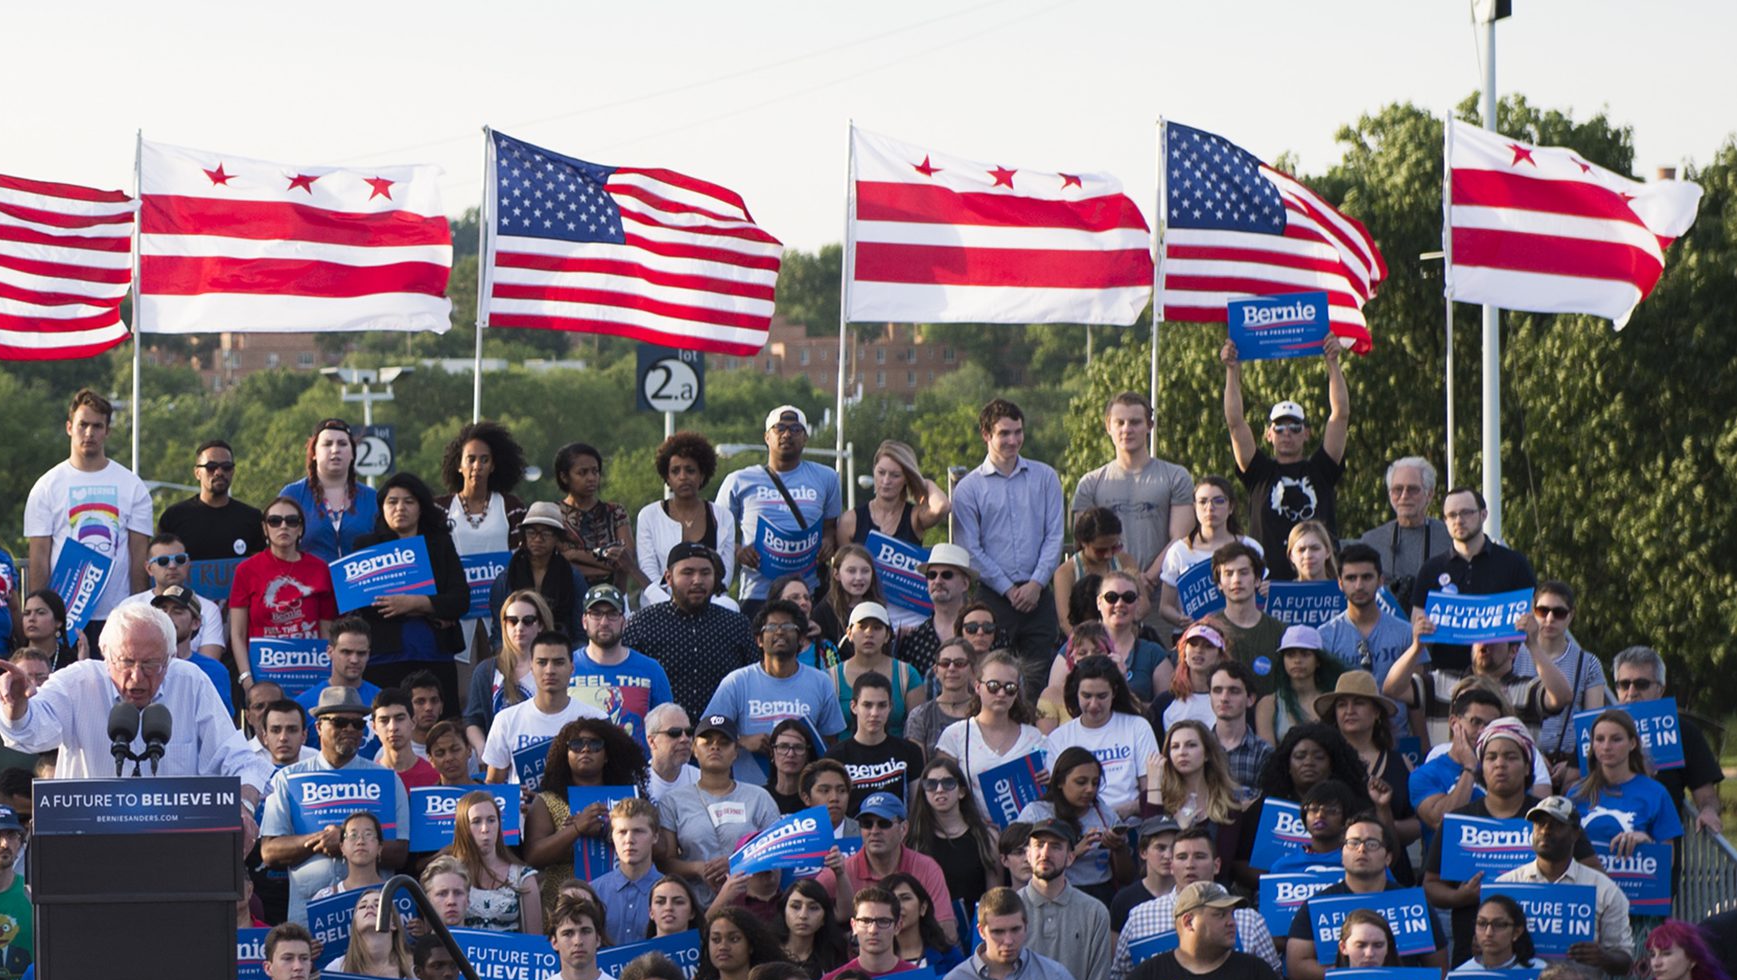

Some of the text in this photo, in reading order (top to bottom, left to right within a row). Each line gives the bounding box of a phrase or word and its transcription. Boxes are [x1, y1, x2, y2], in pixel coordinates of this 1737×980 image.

[1242, 301, 1316, 326] Bernie
[1269, 328, 1304, 336] PRESIDENT
[678, 348, 697, 362] lot
[374, 427, 390, 437] lot
[756, 485, 817, 502] Benie
[763, 526, 819, 554] Bernie
[344, 547, 415, 581] Bernie
[358, 572, 407, 586] FOR PRESIDENT
[64, 563, 103, 631] Bernie
[1272, 595, 1340, 610] A FUTURE
[1430, 600, 1528, 617] A FUTURE TO
[1430, 613, 1495, 629] BELIEVE
[259, 647, 330, 667] Bernie
[615, 674, 651, 688] THE
[748, 700, 809, 717] Bernie
[1652, 715, 1675, 729] TO
[1657, 730, 1677, 746] IN
[846, 757, 907, 780] Bernie
[300, 779, 380, 801] Bernie
[40, 793, 235, 808] A FUTURE TO BELIEVE IN
[96, 814, 178, 822] BERNIESANDERS.COM
[742, 817, 818, 860] Bernie
[1319, 905, 1424, 925] A TO
[1567, 902, 1592, 917] TO
[1406, 918, 1427, 934] IN
[1569, 919, 1592, 936] IN
[467, 946, 556, 965] FUTURE TO
[676, 949, 700, 964] TO
